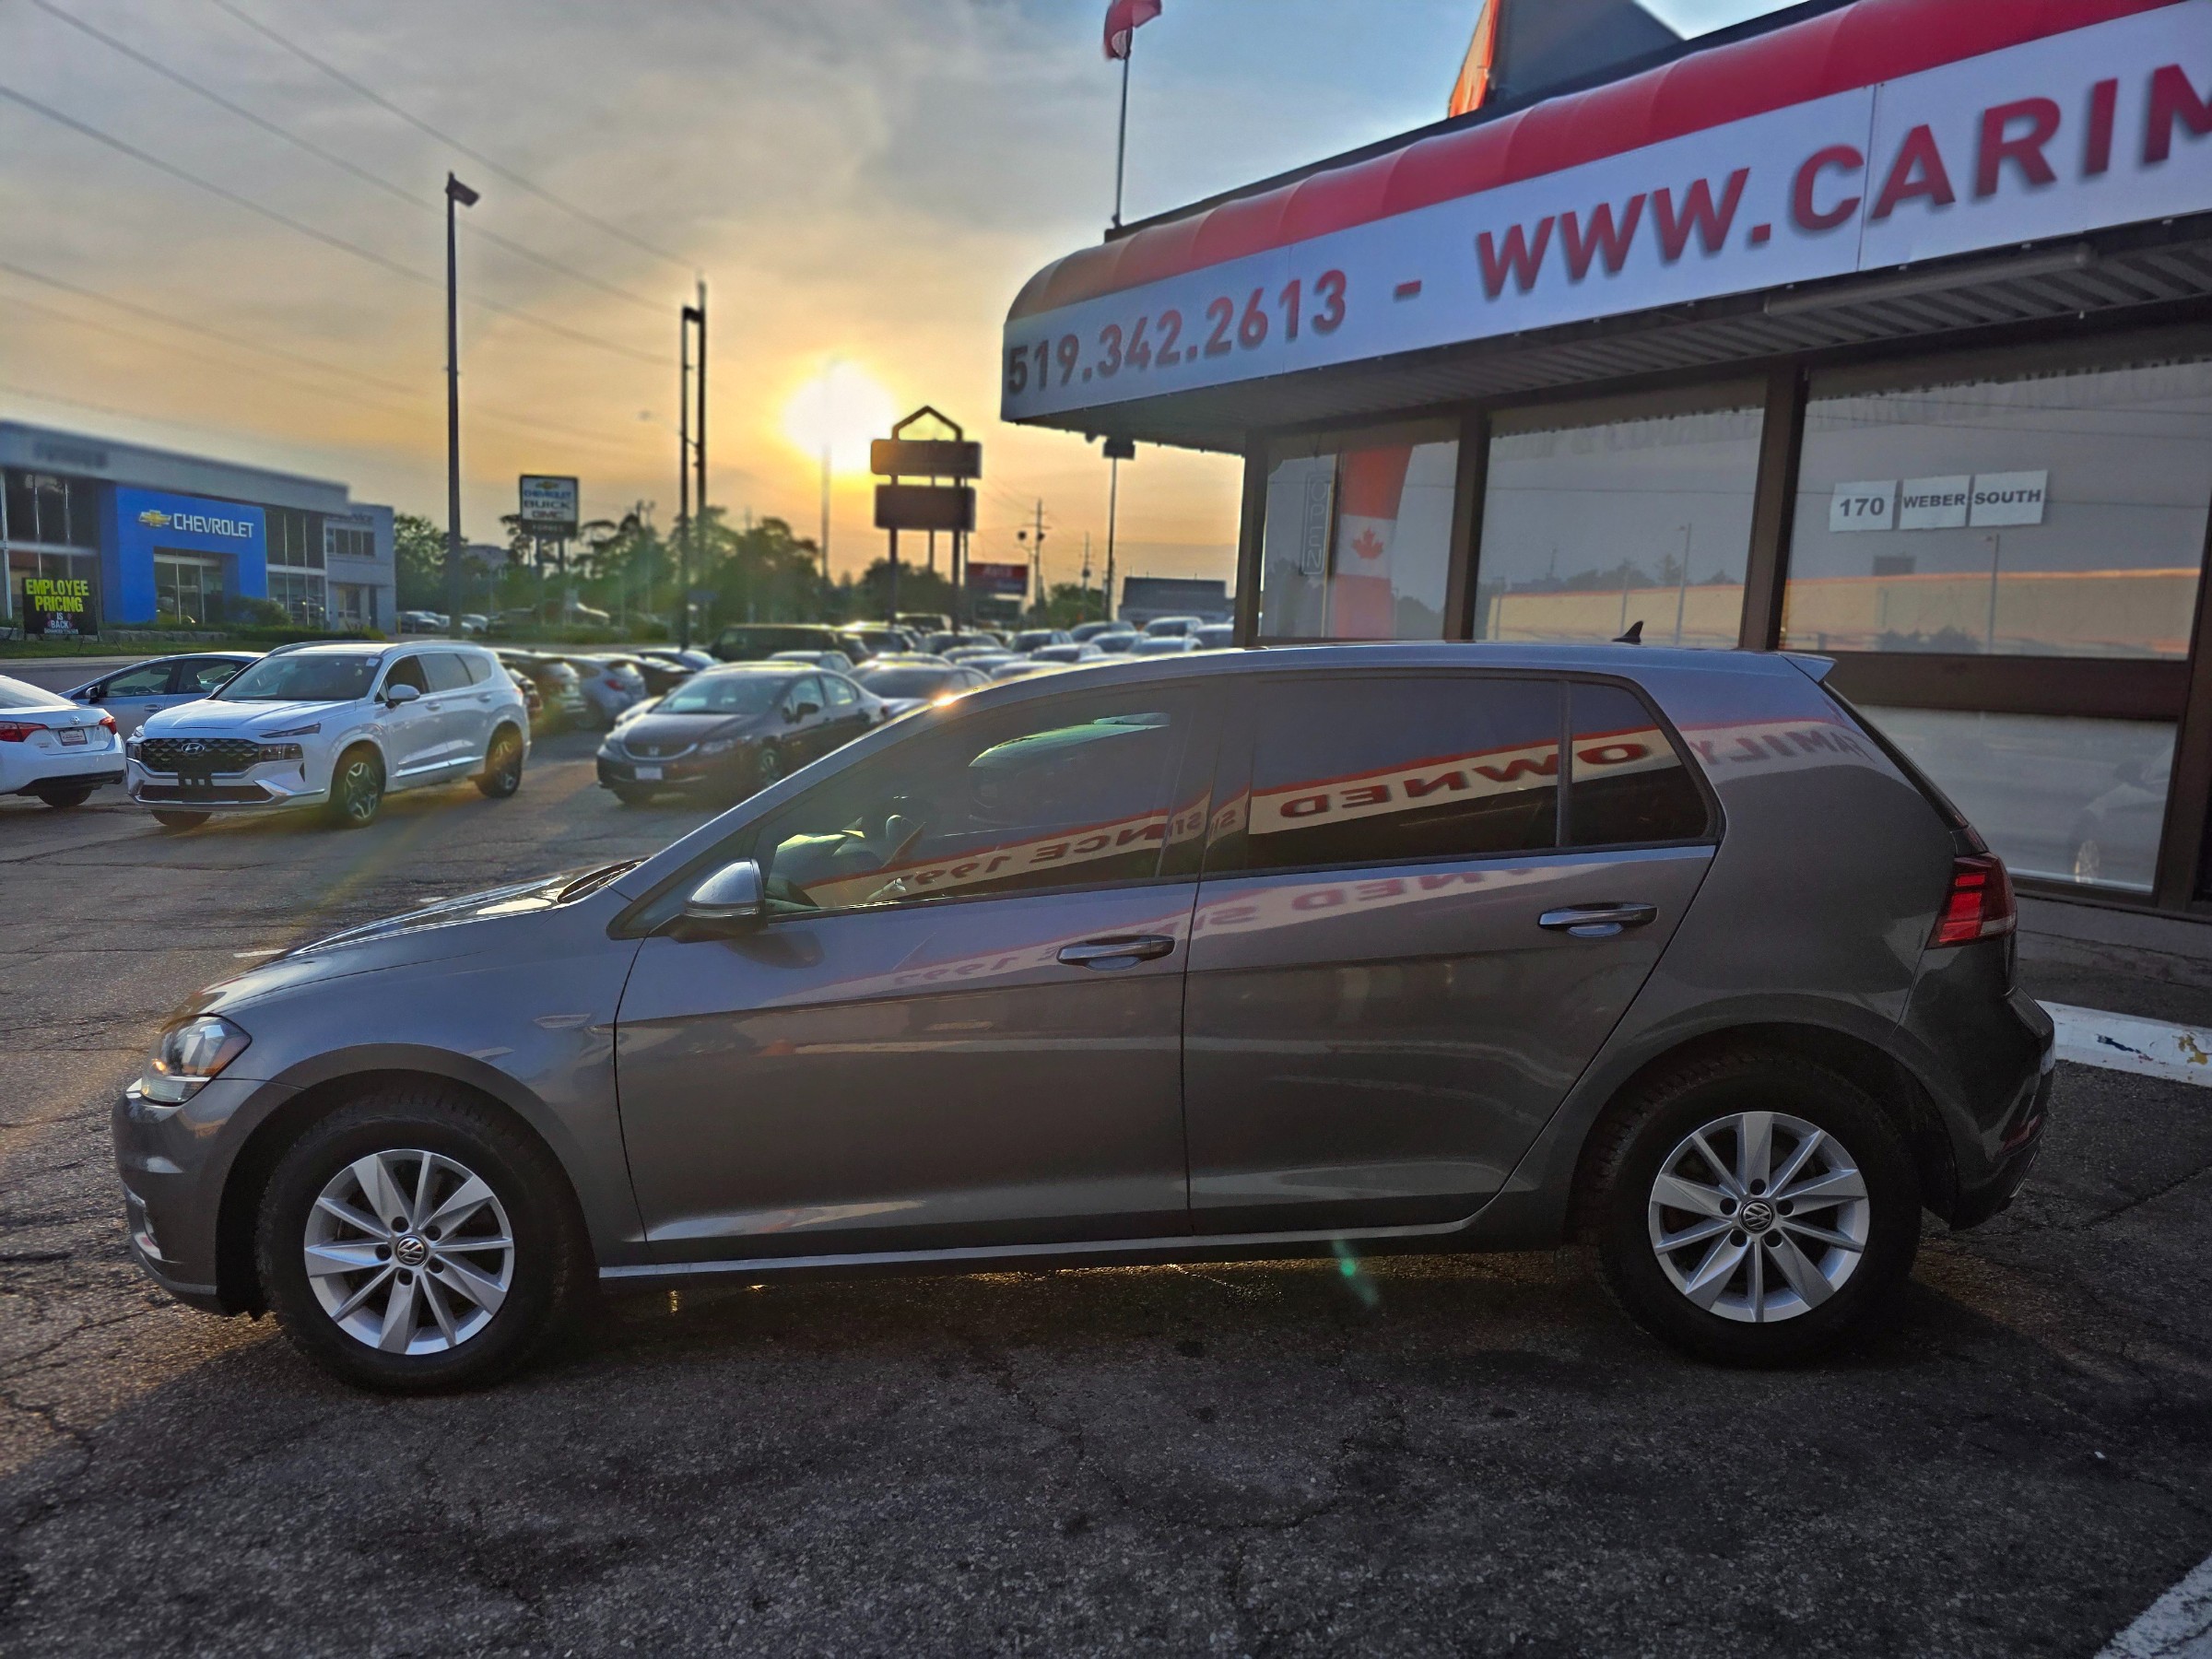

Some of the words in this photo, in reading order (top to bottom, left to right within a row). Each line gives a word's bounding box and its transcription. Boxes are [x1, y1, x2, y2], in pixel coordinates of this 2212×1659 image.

[1007, 268, 1347, 394] 519.342.2613
[1839, 497, 1886, 517] 170
[1902, 492, 1966, 509] WEBER
[1974, 488, 2041, 505] SOUTH
[172, 512, 254, 538] CHEVROLET
[1307, 477, 1328, 569] OPEN
[25, 578, 89, 596] EMPLOYEE
[34, 595, 84, 613] PRICING
[51, 619, 69, 629] BACK
[56, 612, 64, 620] IS
